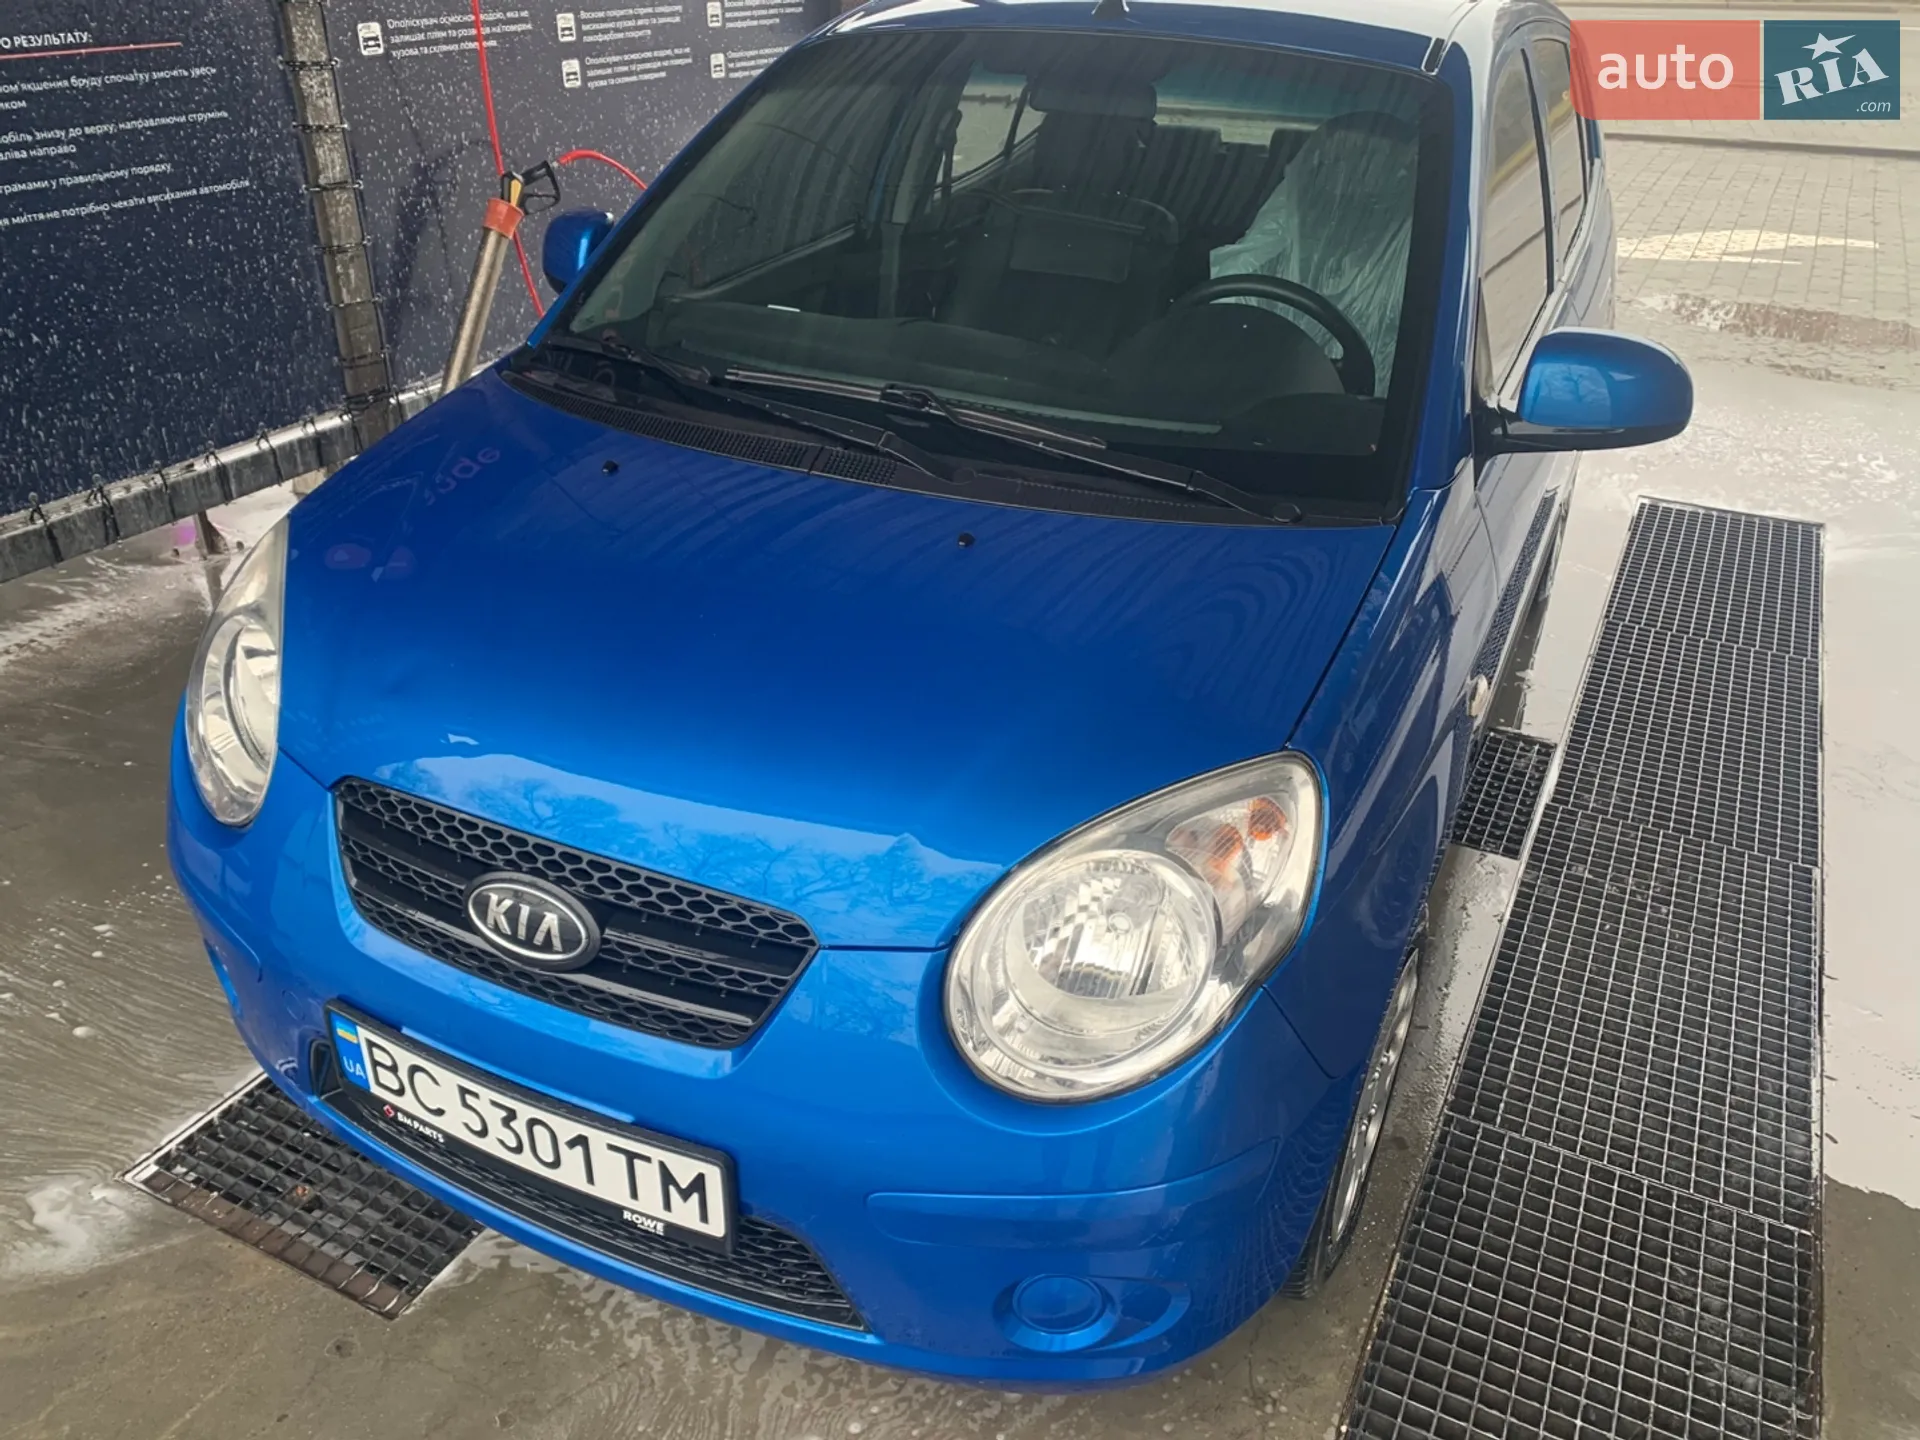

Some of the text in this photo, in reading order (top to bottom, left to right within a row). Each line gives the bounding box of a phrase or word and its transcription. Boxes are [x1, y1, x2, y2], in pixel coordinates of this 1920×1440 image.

[13, 31, 93, 48] РЕЗУЛЬТАТУ:
[0, 80, 70, 94] ом'якшення
[0, 131, 33, 143] обіль
[68, 127, 82, 138] до
[29, 144, 76, 157] направо
[51, 179, 58, 190] у
[59, 169, 129, 187] правильному
[62, 203, 110, 216] потрібно
[485, 892, 563, 952] KIA
[343, 1056, 366, 1080] UA
[366, 1037, 710, 1226] BC 5301 TM
[623, 1210, 664, 1232] ROWE
